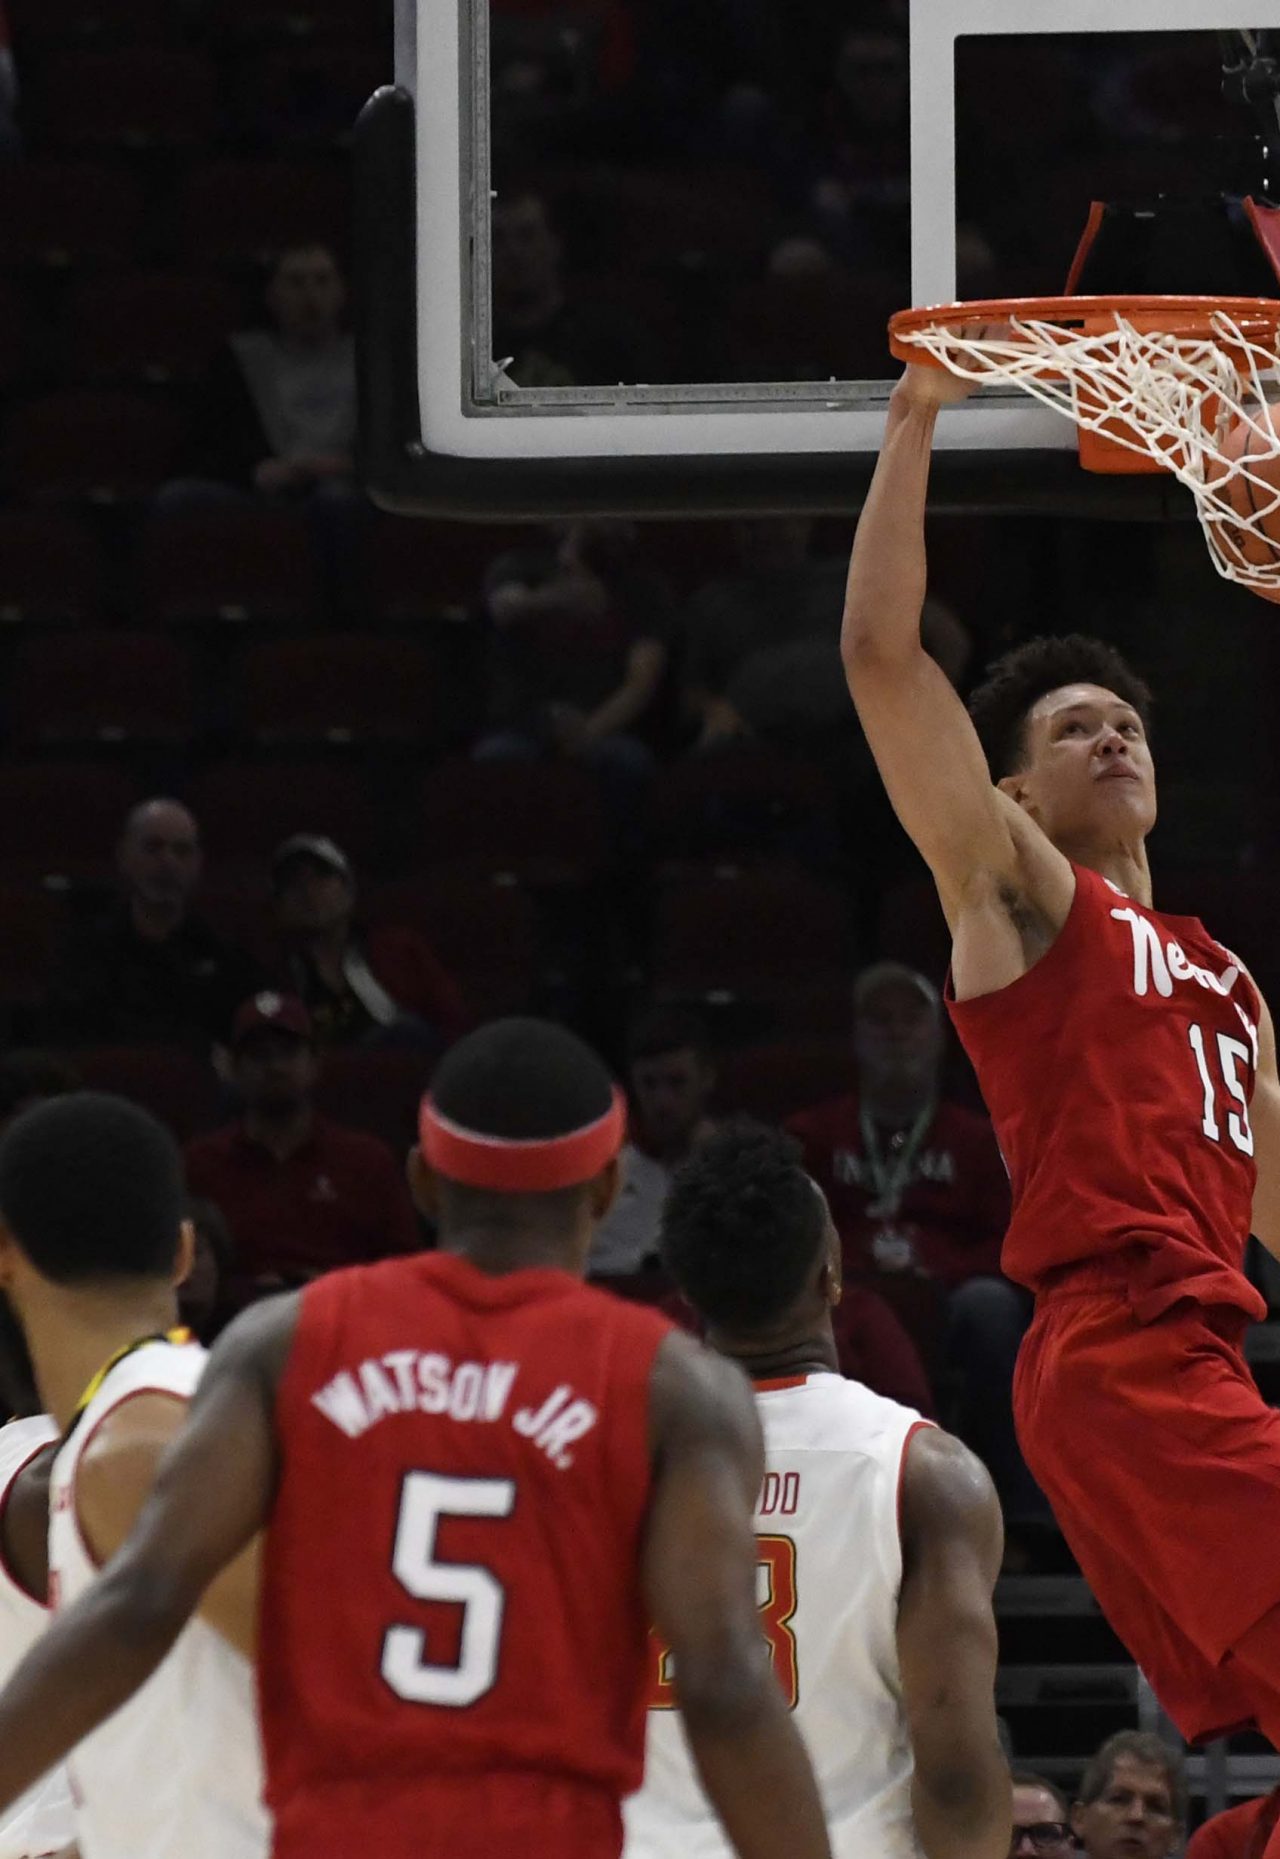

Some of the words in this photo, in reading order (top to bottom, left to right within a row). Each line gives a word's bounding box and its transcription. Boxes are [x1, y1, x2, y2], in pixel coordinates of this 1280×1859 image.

[1188, 1022, 1254, 1158] 15
[309, 1348, 520, 1440] WATSON
[511, 1383, 599, 1472] JR.
[379, 1468, 517, 1709] 5
